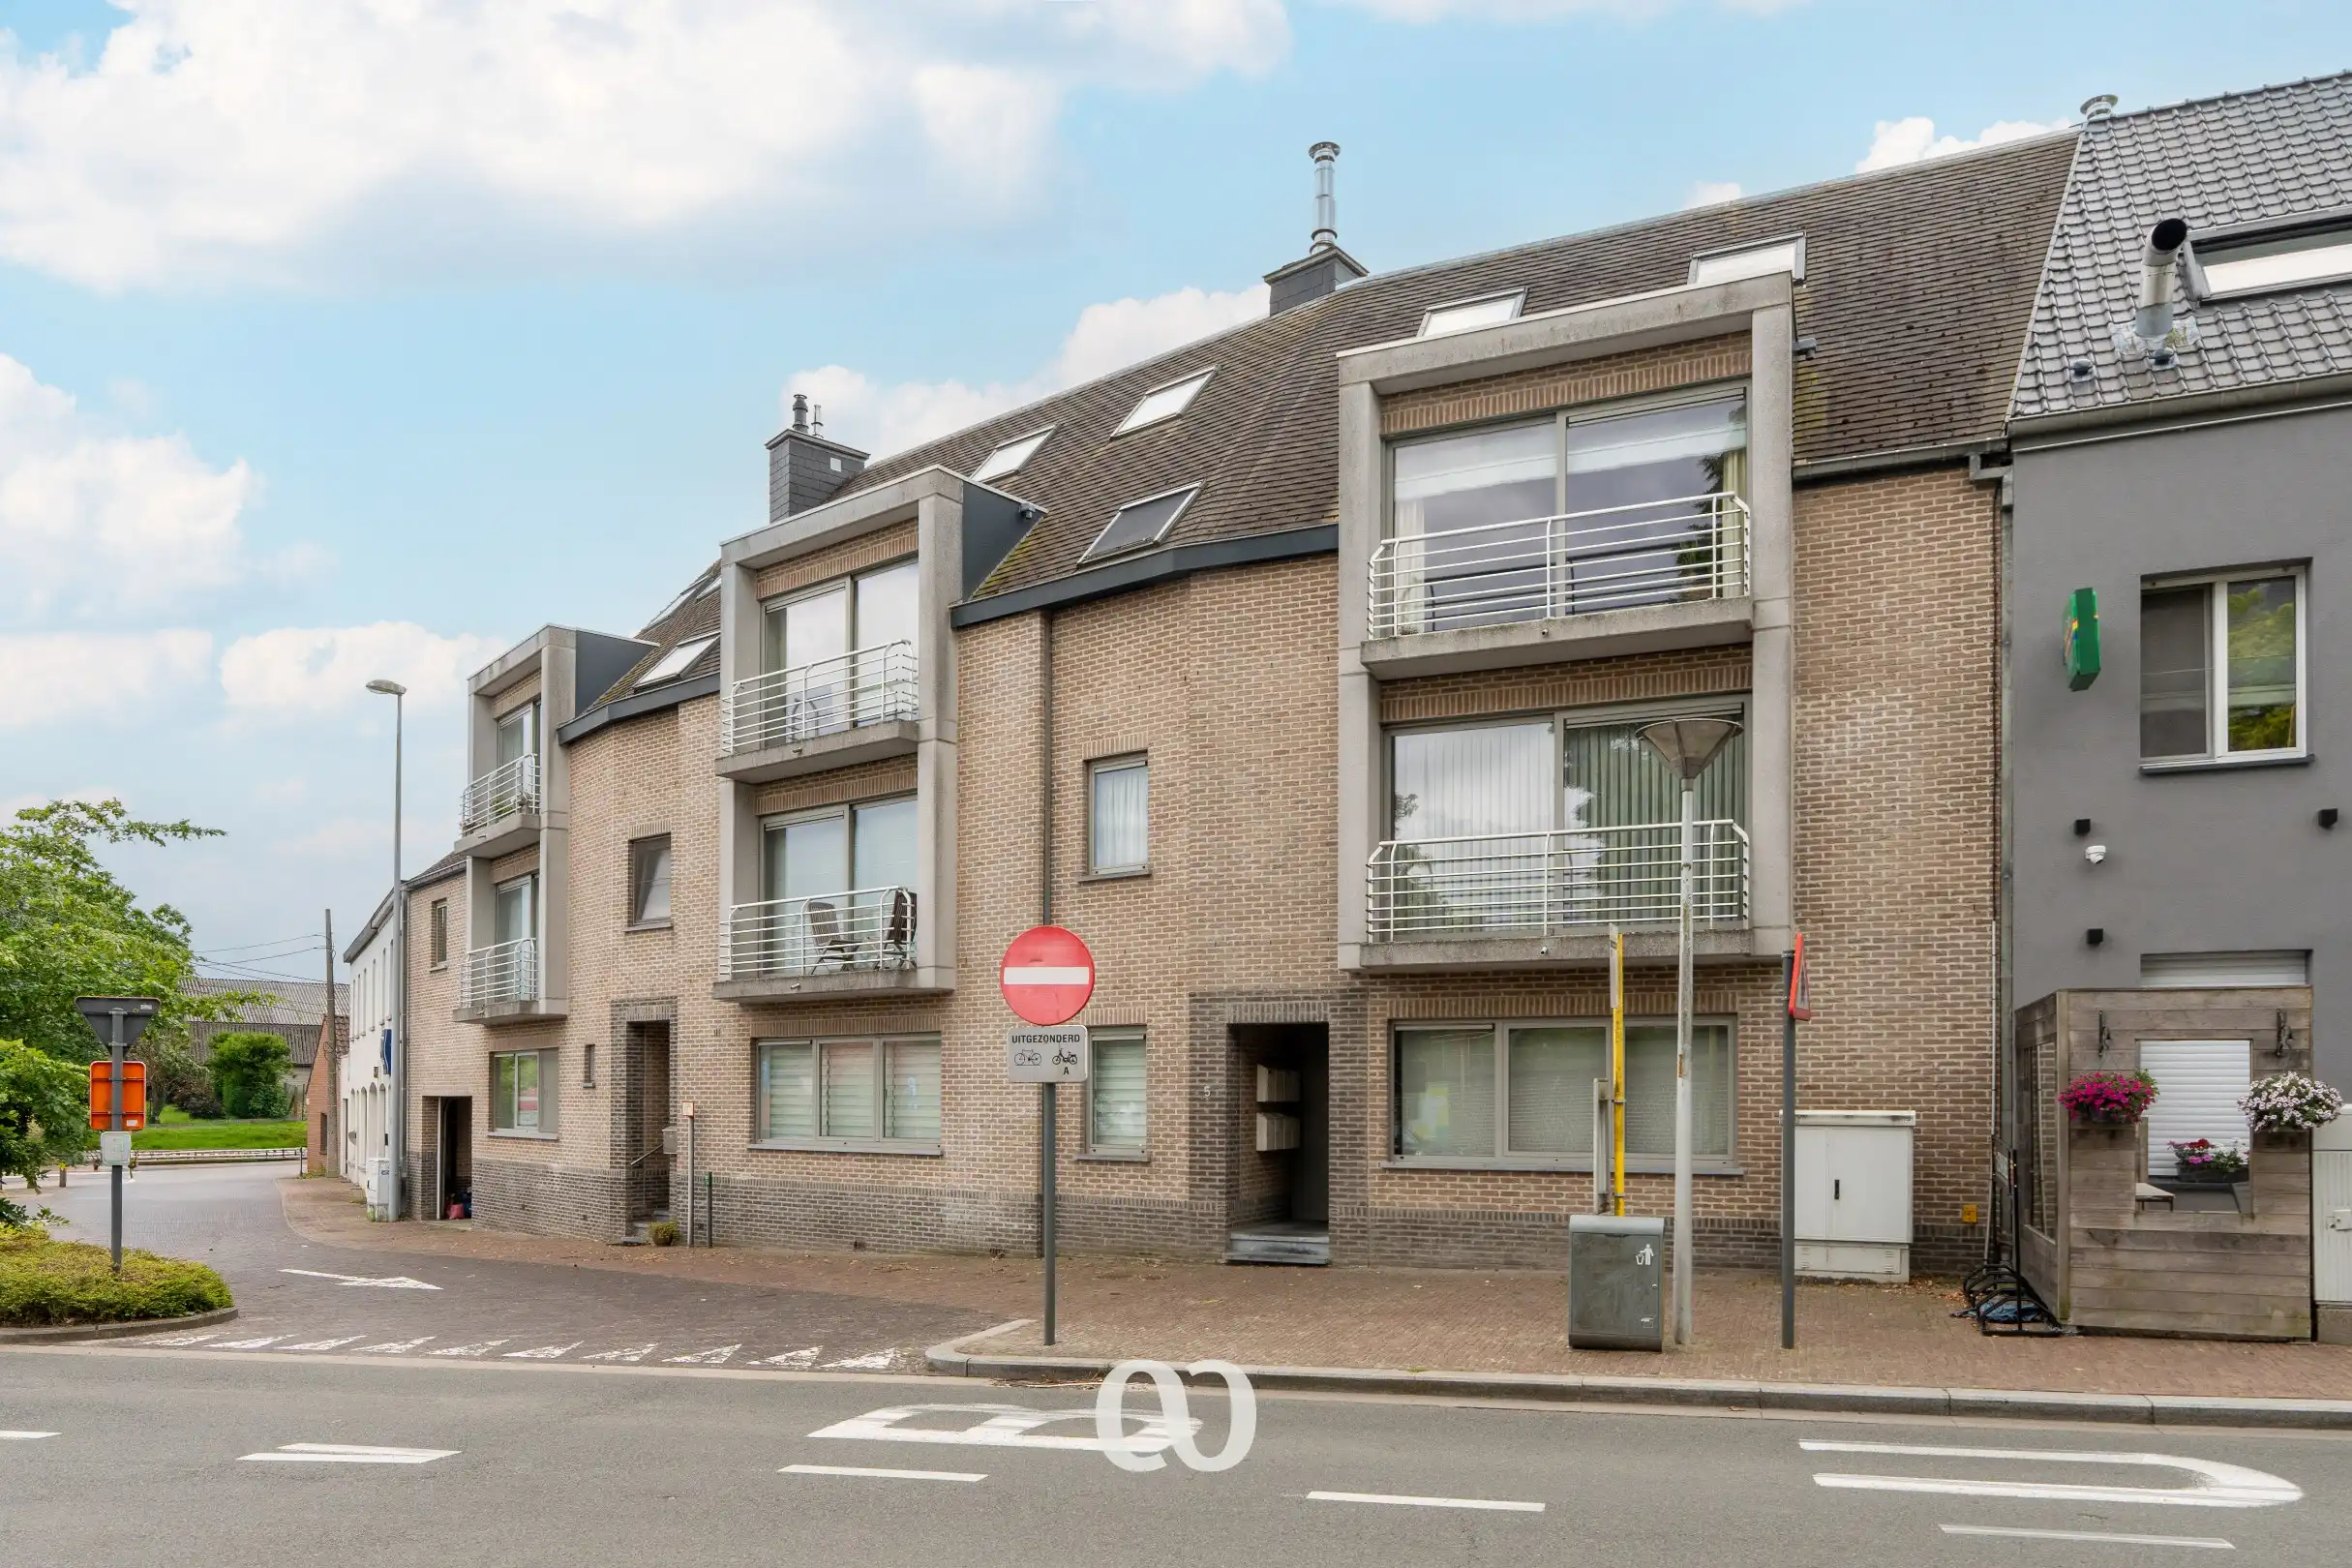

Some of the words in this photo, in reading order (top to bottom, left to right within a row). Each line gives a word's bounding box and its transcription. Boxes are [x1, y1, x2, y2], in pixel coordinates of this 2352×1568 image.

[1011, 1034, 1081, 1044] UITGEZONDERD
[1063, 1067, 1070, 1075] A
[1203, 1085, 1211, 1098] 5
